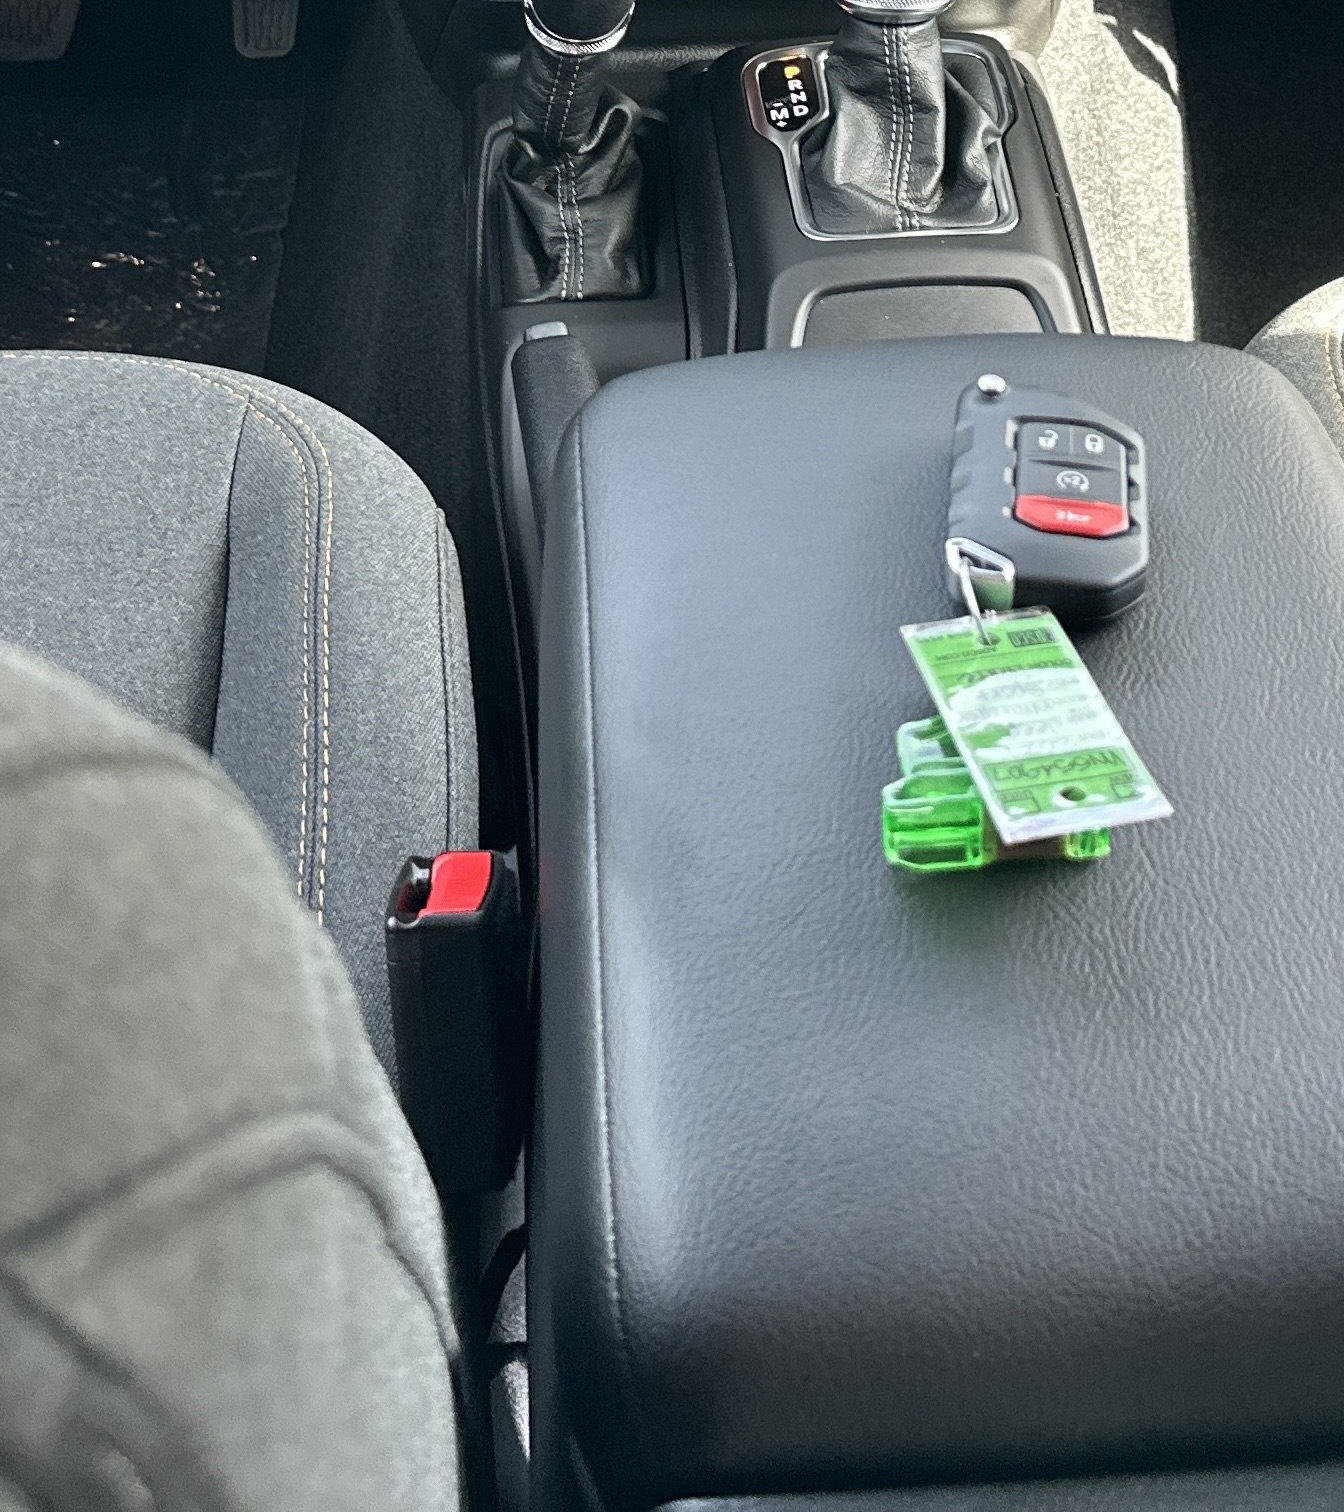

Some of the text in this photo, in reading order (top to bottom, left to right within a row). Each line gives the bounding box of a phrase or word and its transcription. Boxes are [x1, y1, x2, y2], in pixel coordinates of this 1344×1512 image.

[787, 79, 803, 91] R
[790, 91, 807, 104] N
[770, 107, 789, 121] M
[792, 105, 809, 117] D
